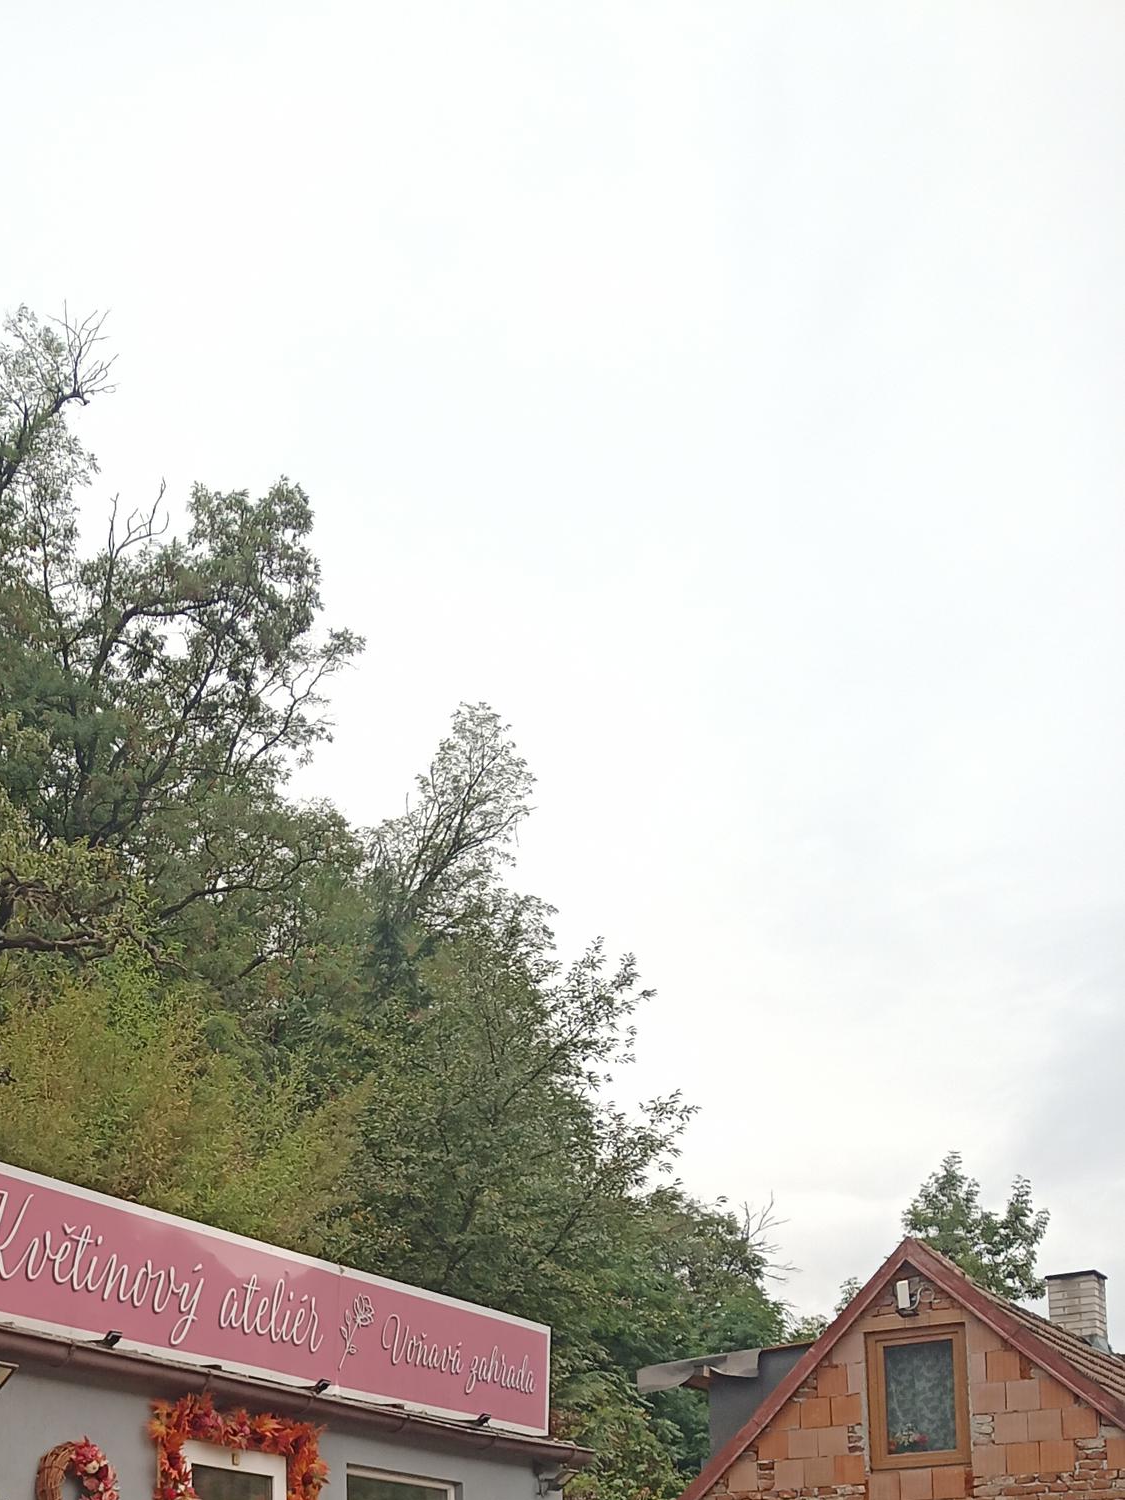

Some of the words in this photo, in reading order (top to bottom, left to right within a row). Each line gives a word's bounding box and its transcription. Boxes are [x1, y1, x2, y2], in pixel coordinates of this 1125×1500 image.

[218, 1273, 324, 1354] ateliér
[381, 1313, 464, 1375] Voňavá
[464, 1345, 537, 1395] zahrada
